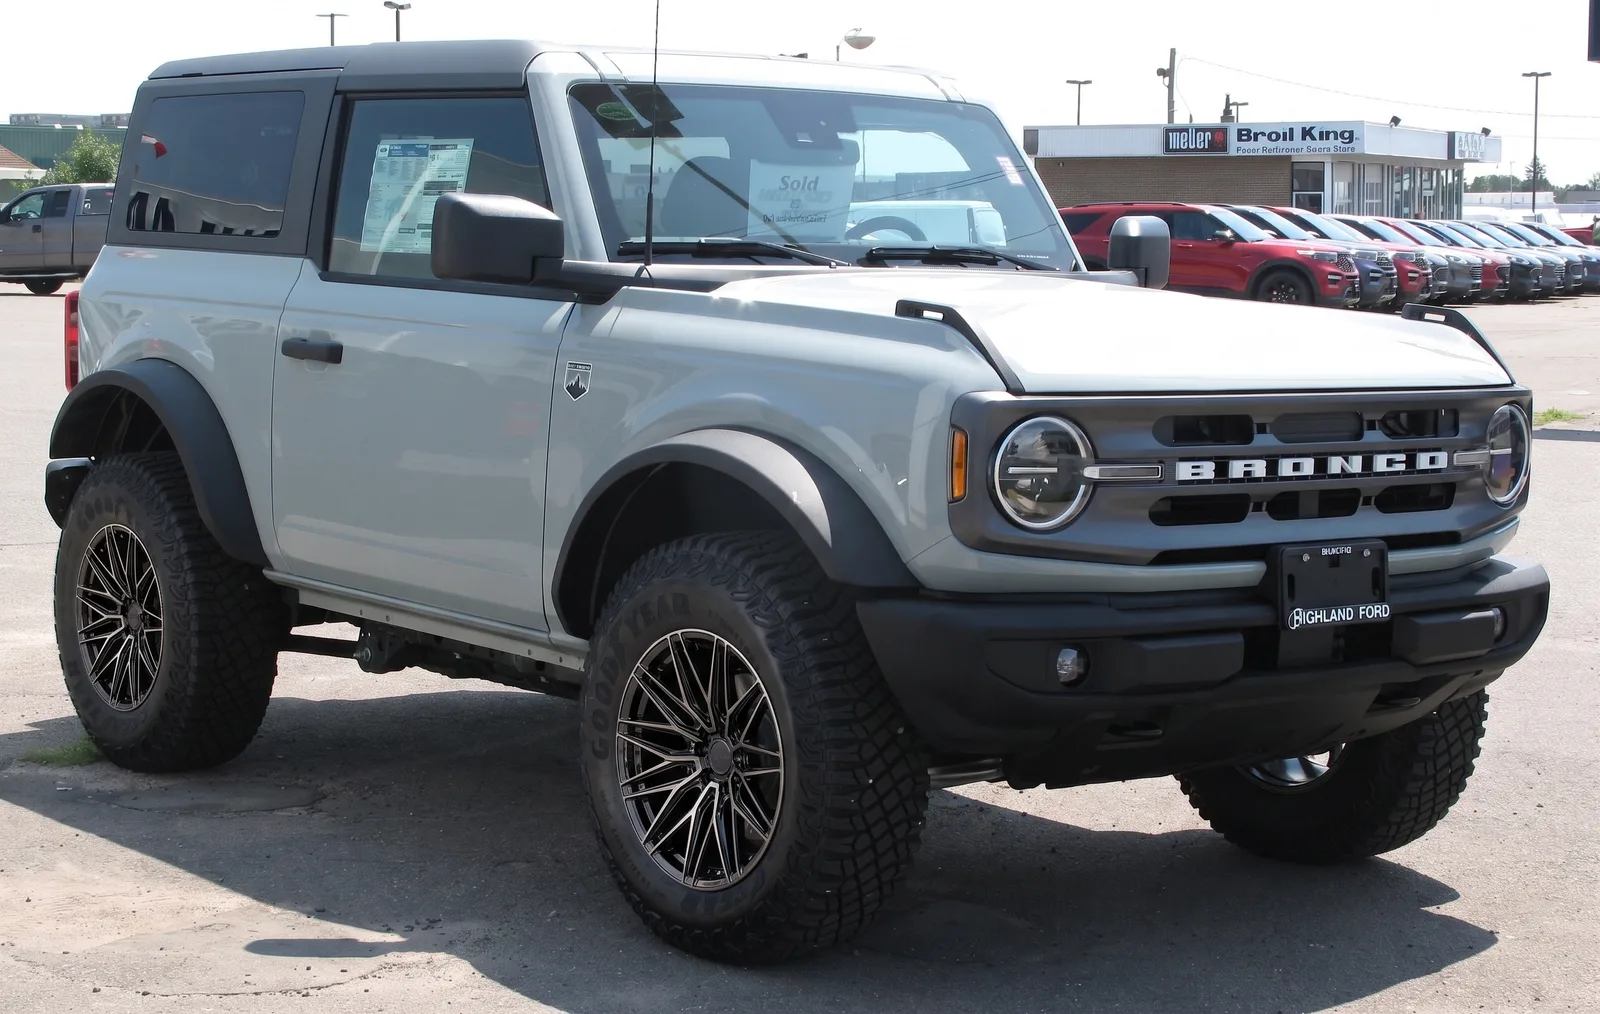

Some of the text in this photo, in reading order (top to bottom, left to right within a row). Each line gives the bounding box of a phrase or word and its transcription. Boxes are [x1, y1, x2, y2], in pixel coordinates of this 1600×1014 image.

[1236, 126, 1354, 145] Broil King
[778, 175, 820, 192] Sold
[1175, 451, 1448, 481] BRONCO
[1359, 604, 1390, 619] FORD
